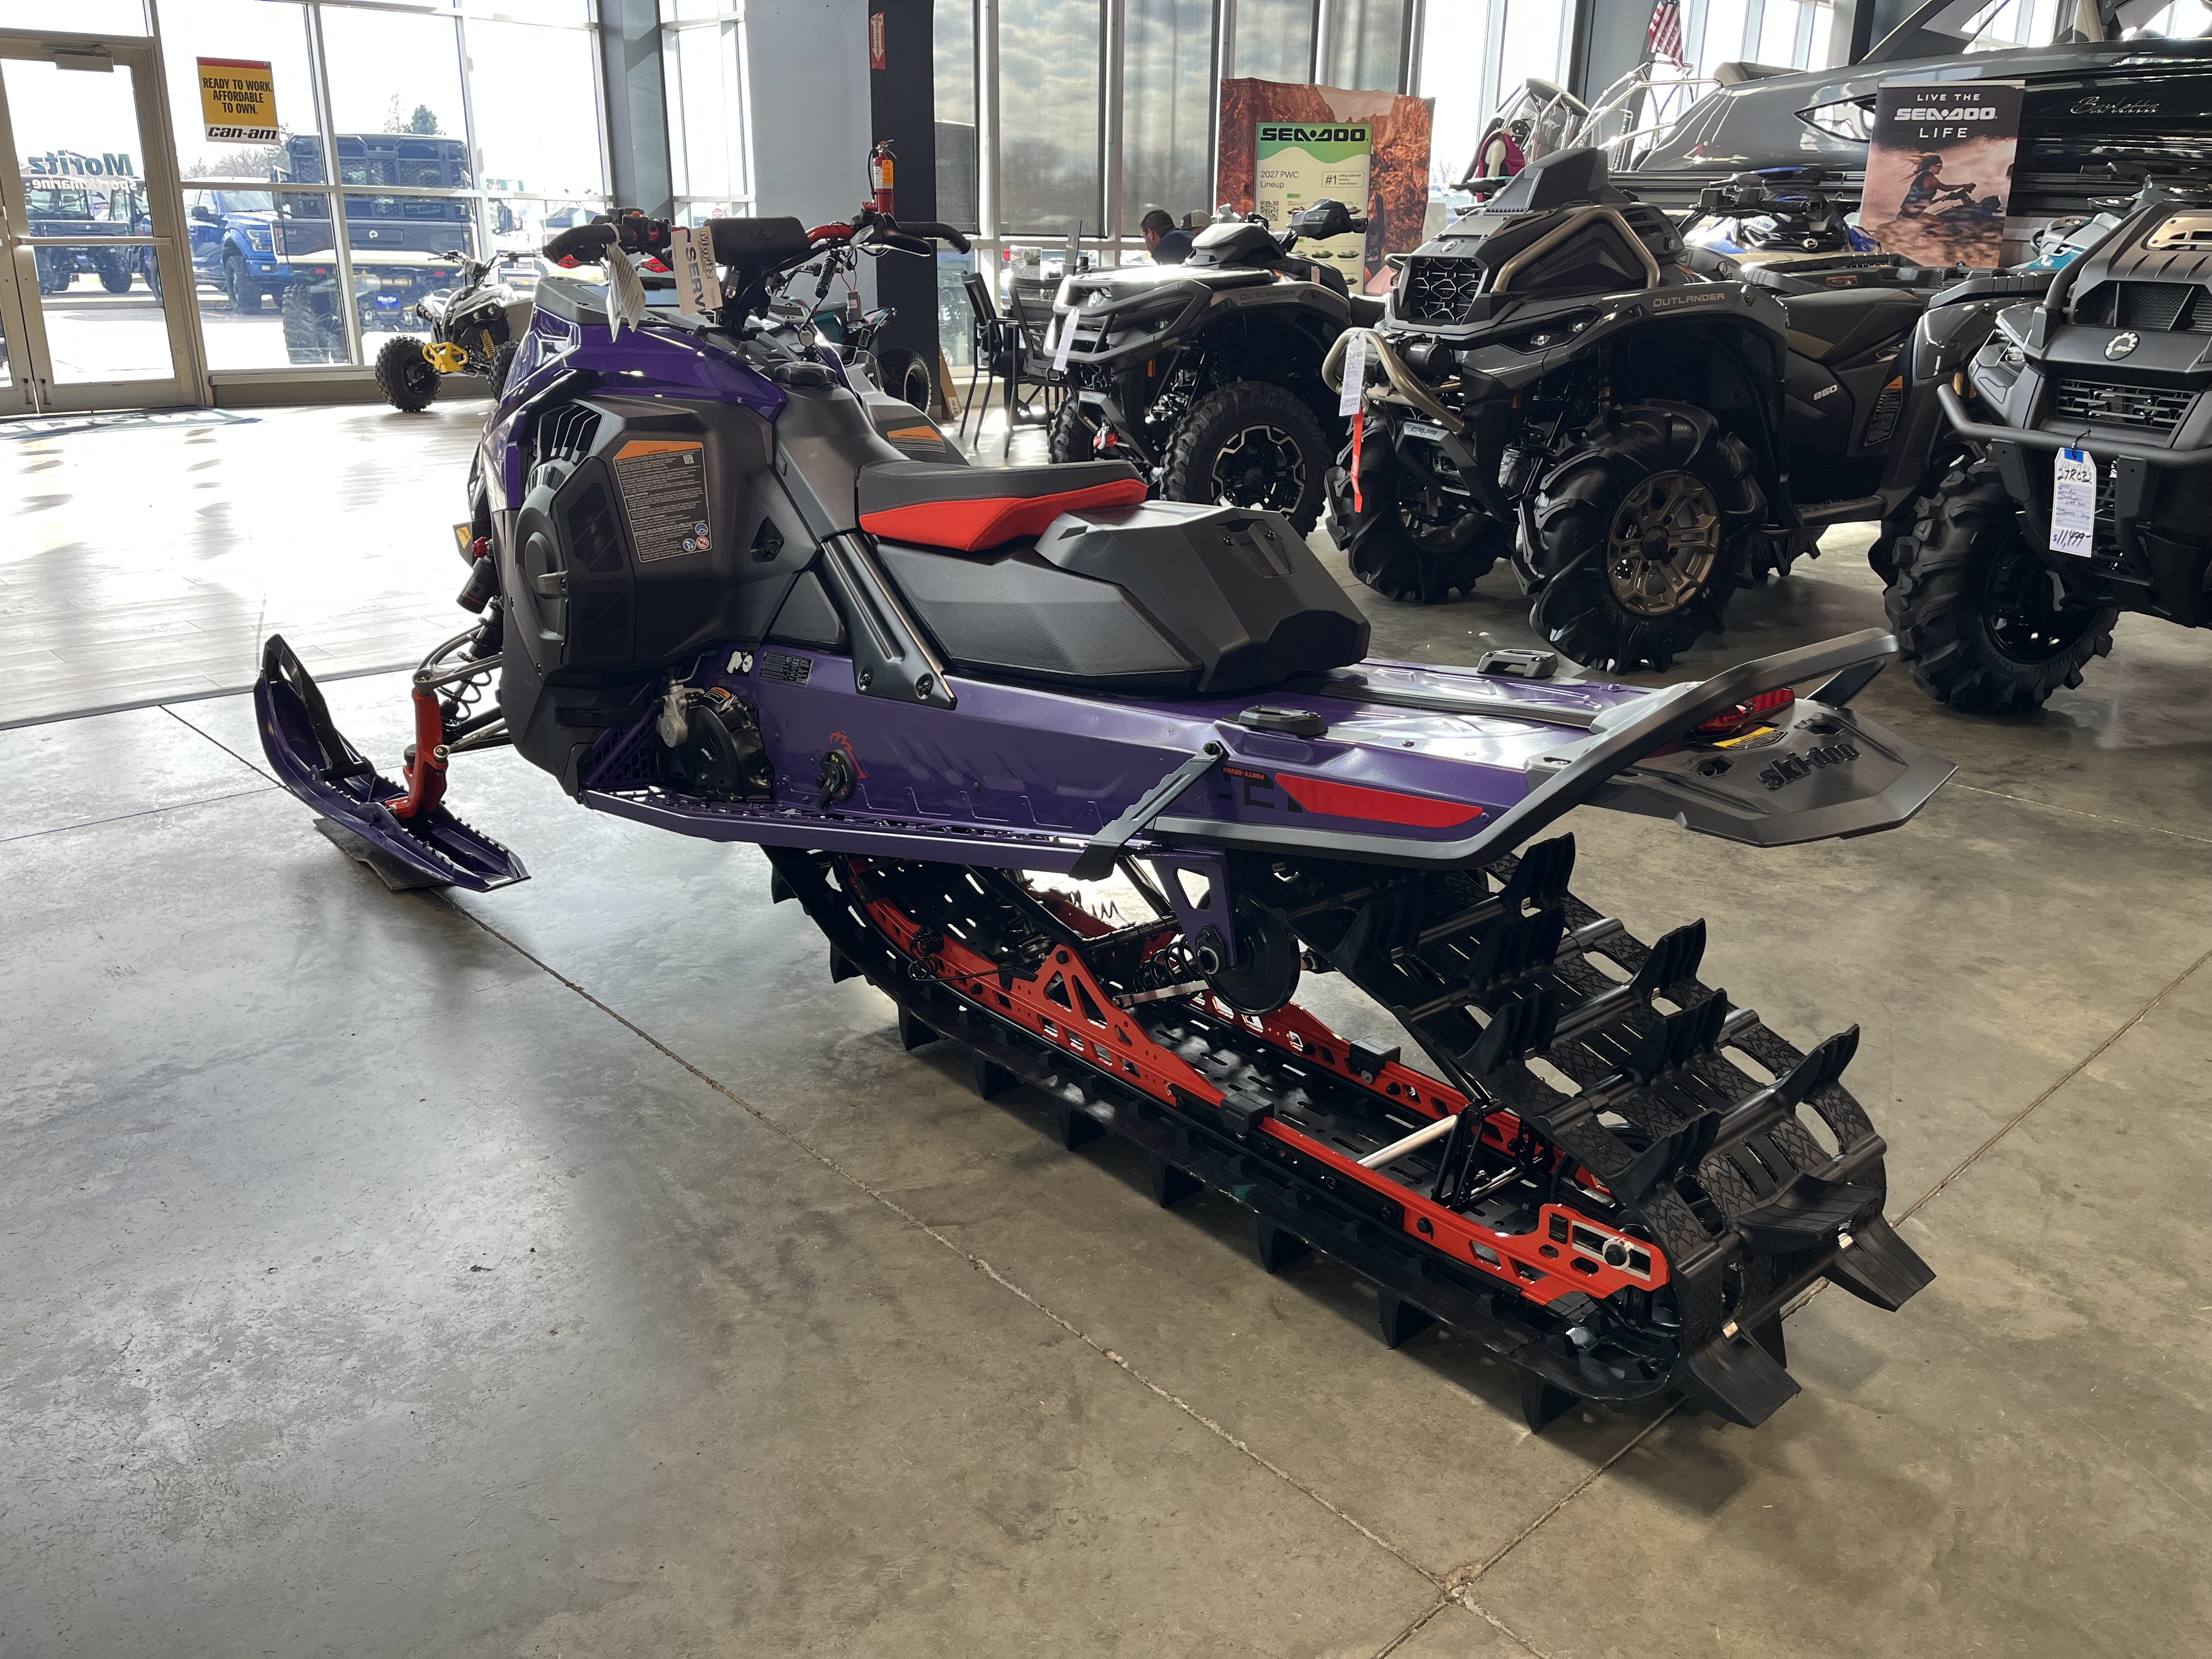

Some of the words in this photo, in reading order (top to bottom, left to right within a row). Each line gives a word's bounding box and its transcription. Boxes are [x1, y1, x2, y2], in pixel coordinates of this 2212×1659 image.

[202, 77, 229, 89] READY
[232, 79, 244, 91] TO
[245, 80, 273, 92] WORK.
[213, 90, 264, 103] AFFORDABLE
[222, 103, 233, 113] TO
[236, 104, 258, 115] OWN.
[2070, 96, 2160, 114] Barletta
[208, 127, 278, 140] can-am
[1919, 127, 1968, 138] LIFE
[1280, 171, 1299, 179] PWC
[1325, 174, 1337, 185] #1
[1261, 181, 1284, 189] Lineup
[699, 231, 713, 279] Moritz
[1240, 289, 1296, 301] OUTLANDER
[1653, 292, 1725, 307] OUTLANDER
[1814, 384, 1837, 400] 850
[1410, 426, 1437, 437] can-am
